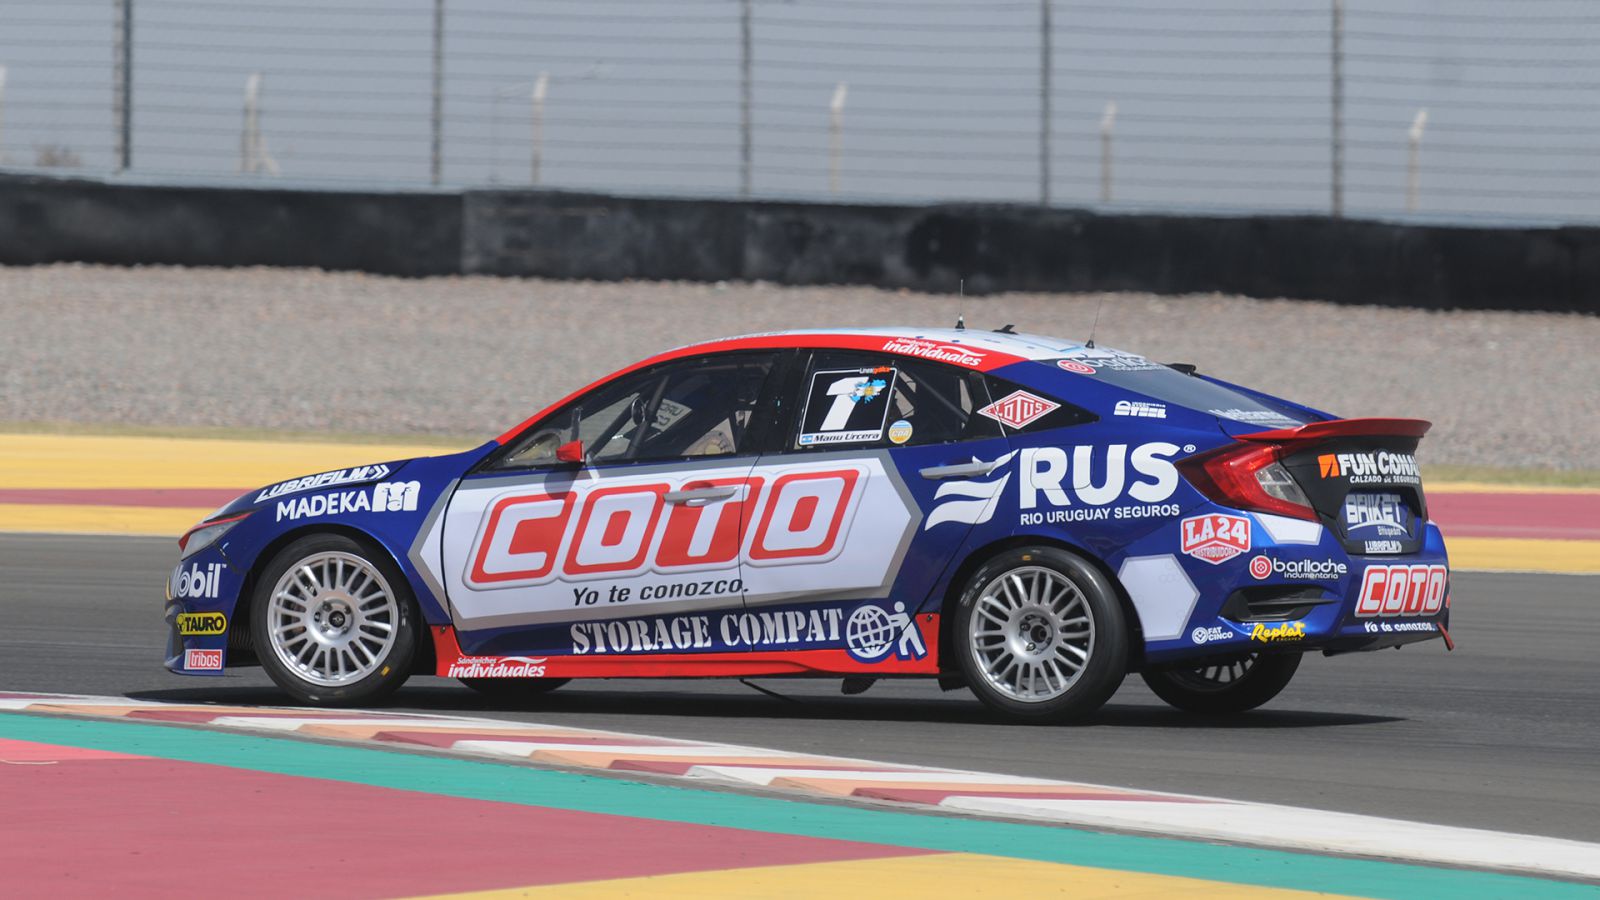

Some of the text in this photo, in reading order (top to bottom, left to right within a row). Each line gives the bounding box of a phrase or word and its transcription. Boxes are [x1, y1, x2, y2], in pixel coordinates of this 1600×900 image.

[882, 341, 981, 366] individuales
[820, 376, 869, 431] 1
[995, 395, 1043, 423] LOTUS
[814, 432, 879, 442] Manu Urcera
[257, 466, 368, 501] LUBRIFILM
[1019, 442, 1181, 509] RUS
[1350, 475, 1382, 484] CALZADO
[276, 490, 371, 522] MADEKA
[1020, 504, 1180, 525] RIO URUGUAY SEGUROS
[470, 469, 860, 584] COTO
[1273, 557, 1347, 574] bariloche
[1284, 571, 1338, 579] Indumentaria
[573, 578, 750, 606] Yo te conozco.
[1357, 567, 1447, 614] COTO
[185, 615, 225, 632] TAURO
[570, 608, 843, 654] STORAGE COMPAT
[1208, 626, 1222, 634] FAT
[1208, 631, 1233, 641] CINCO
[191, 650, 220, 667] tribos
[448, 663, 546, 678] individuales
